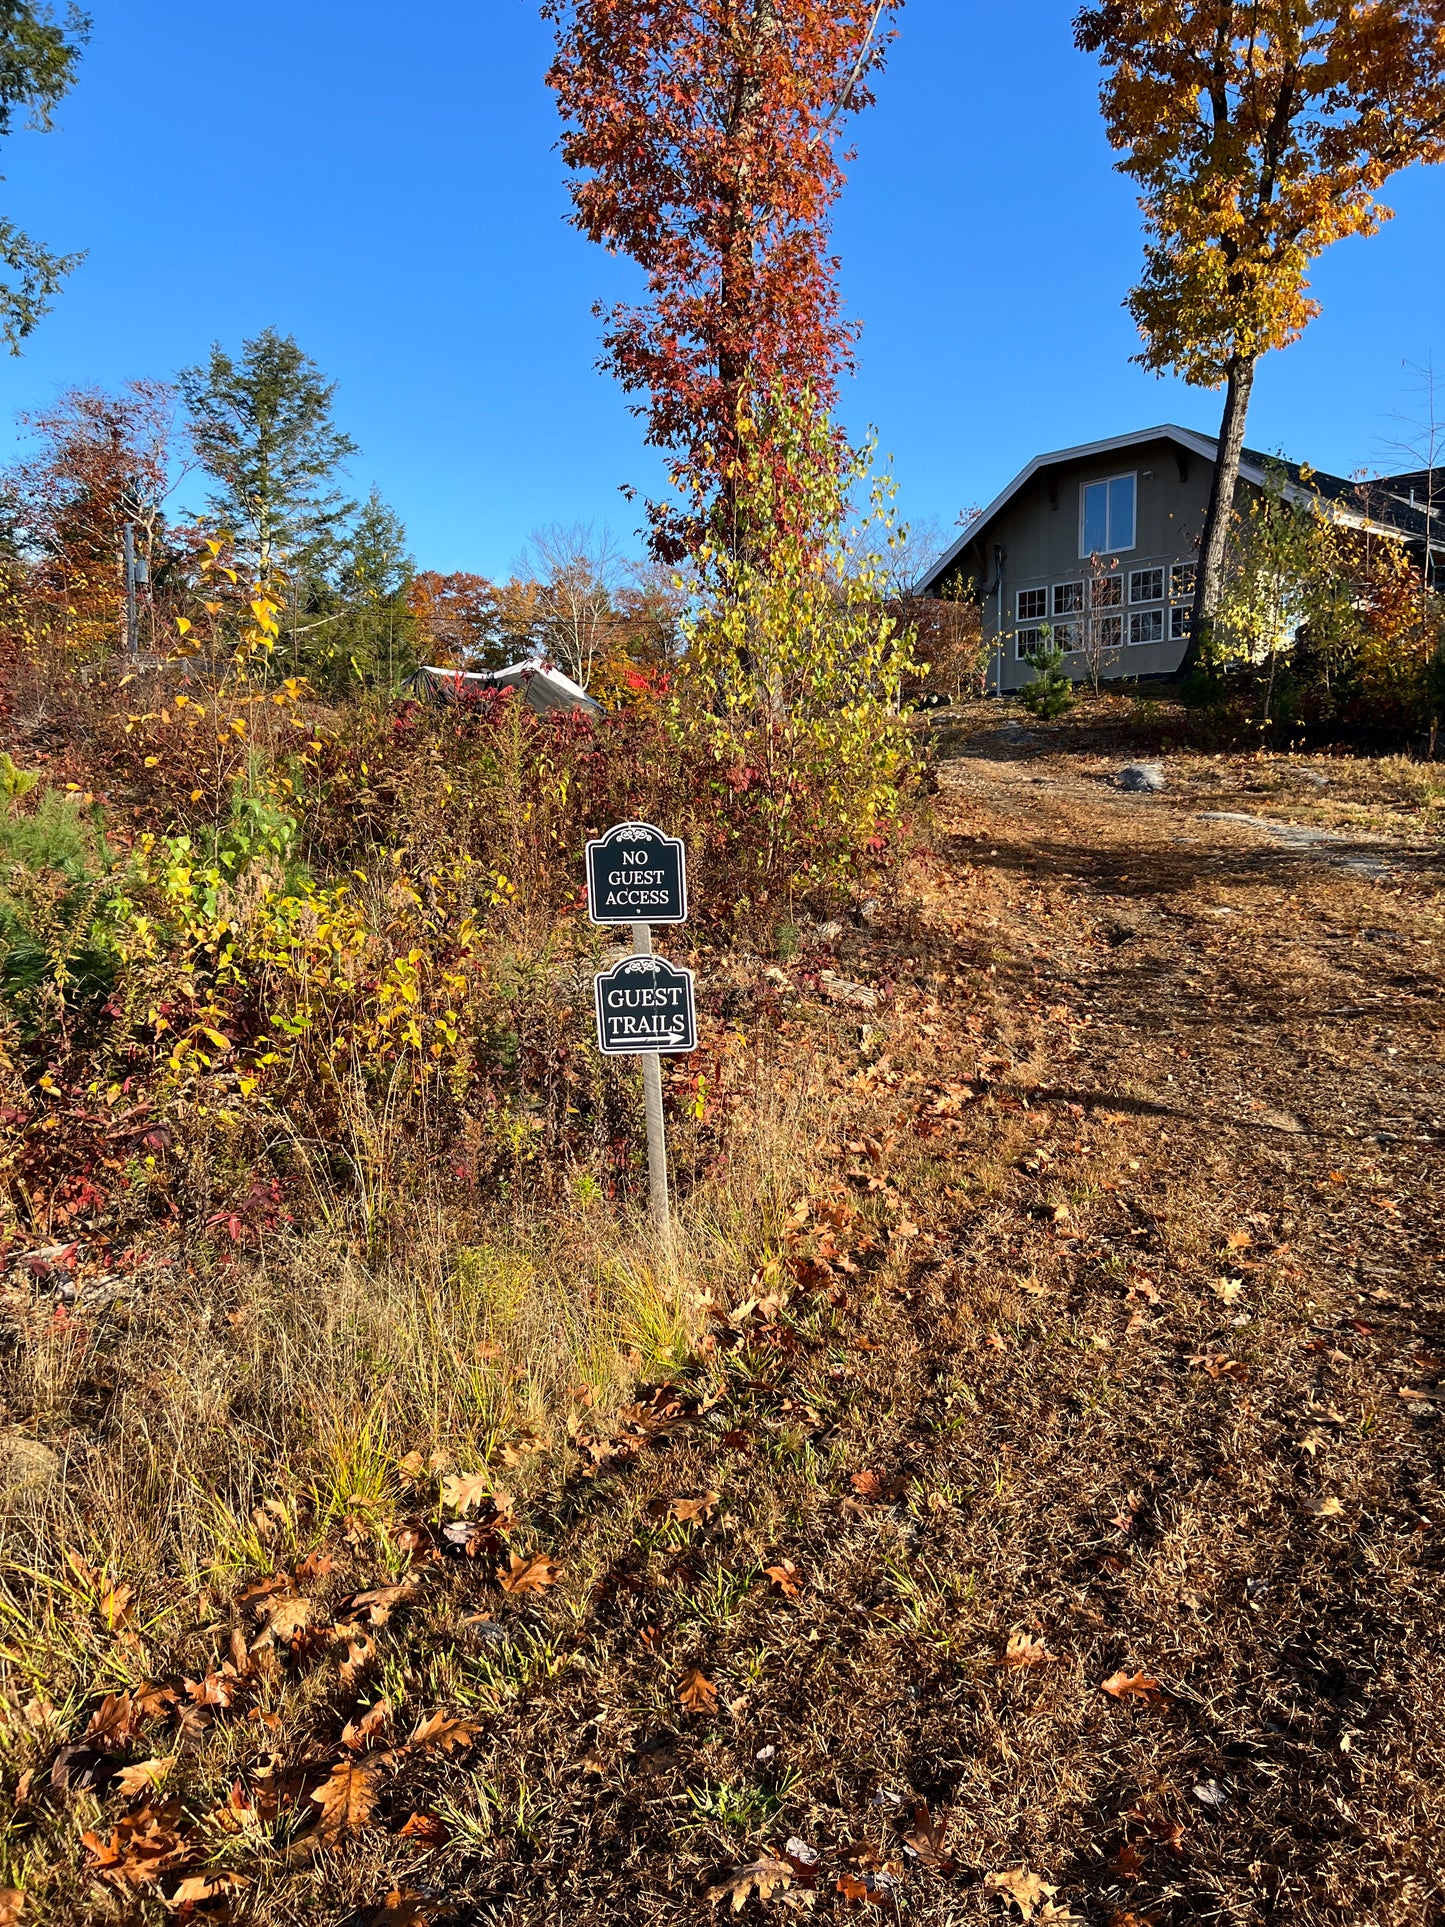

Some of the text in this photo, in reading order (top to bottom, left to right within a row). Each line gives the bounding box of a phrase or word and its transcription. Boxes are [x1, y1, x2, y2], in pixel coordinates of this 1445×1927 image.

[622, 850, 648, 865] NO
[608, 870, 665, 885] GUEST
[605, 890, 669, 905] ACCESS
[607, 987, 682, 1008] GUEST
[608, 1014, 685, 1034] TRAILS
